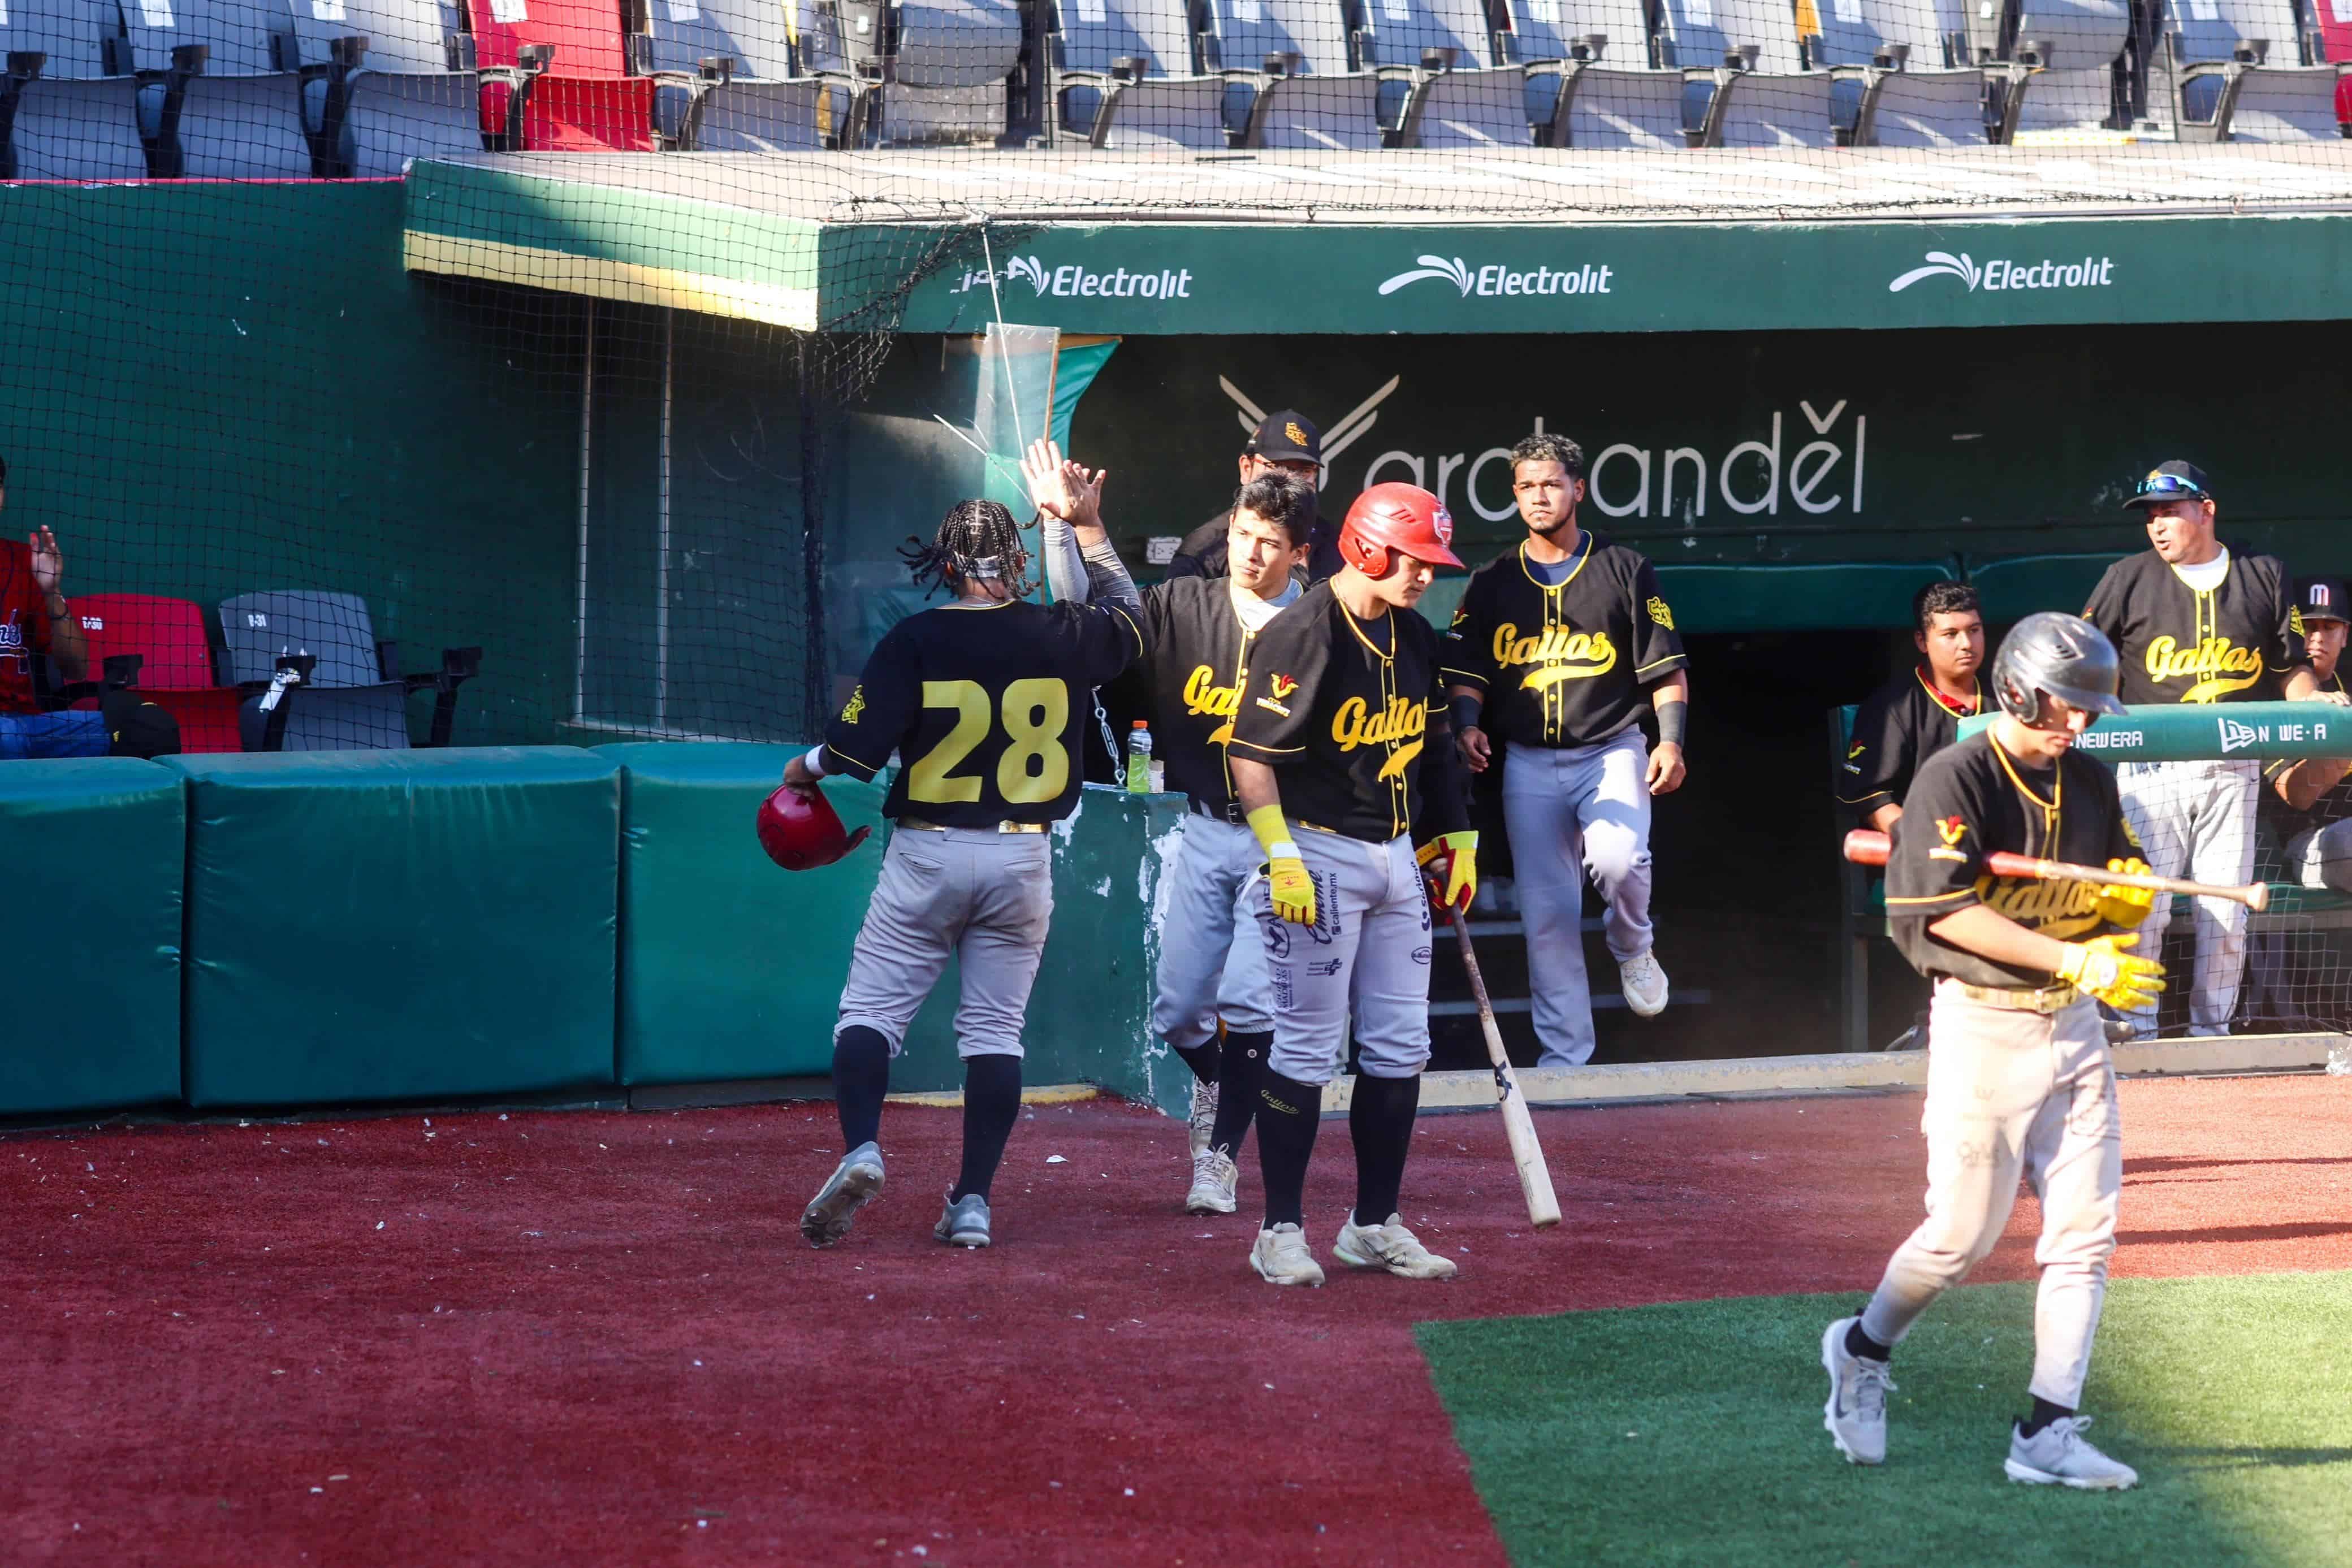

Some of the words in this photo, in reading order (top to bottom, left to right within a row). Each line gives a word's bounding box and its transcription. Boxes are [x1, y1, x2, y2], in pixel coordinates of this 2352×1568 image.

[1052, 266, 1192, 300] Electrolit
[1476, 264, 1613, 296] Electrolit
[1983, 257, 2114, 291] Electrolit
[1363, 399, 1866, 521] arcanděl
[1493, 622, 1611, 670] Gallos
[2146, 635, 2261, 682] Gallos
[1183, 665, 1247, 716] Gal
[907, 678, 1070, 805] 28
[1331, 696, 1429, 752] Gallo
[1329, 872, 1339, 925] caliente.mx
